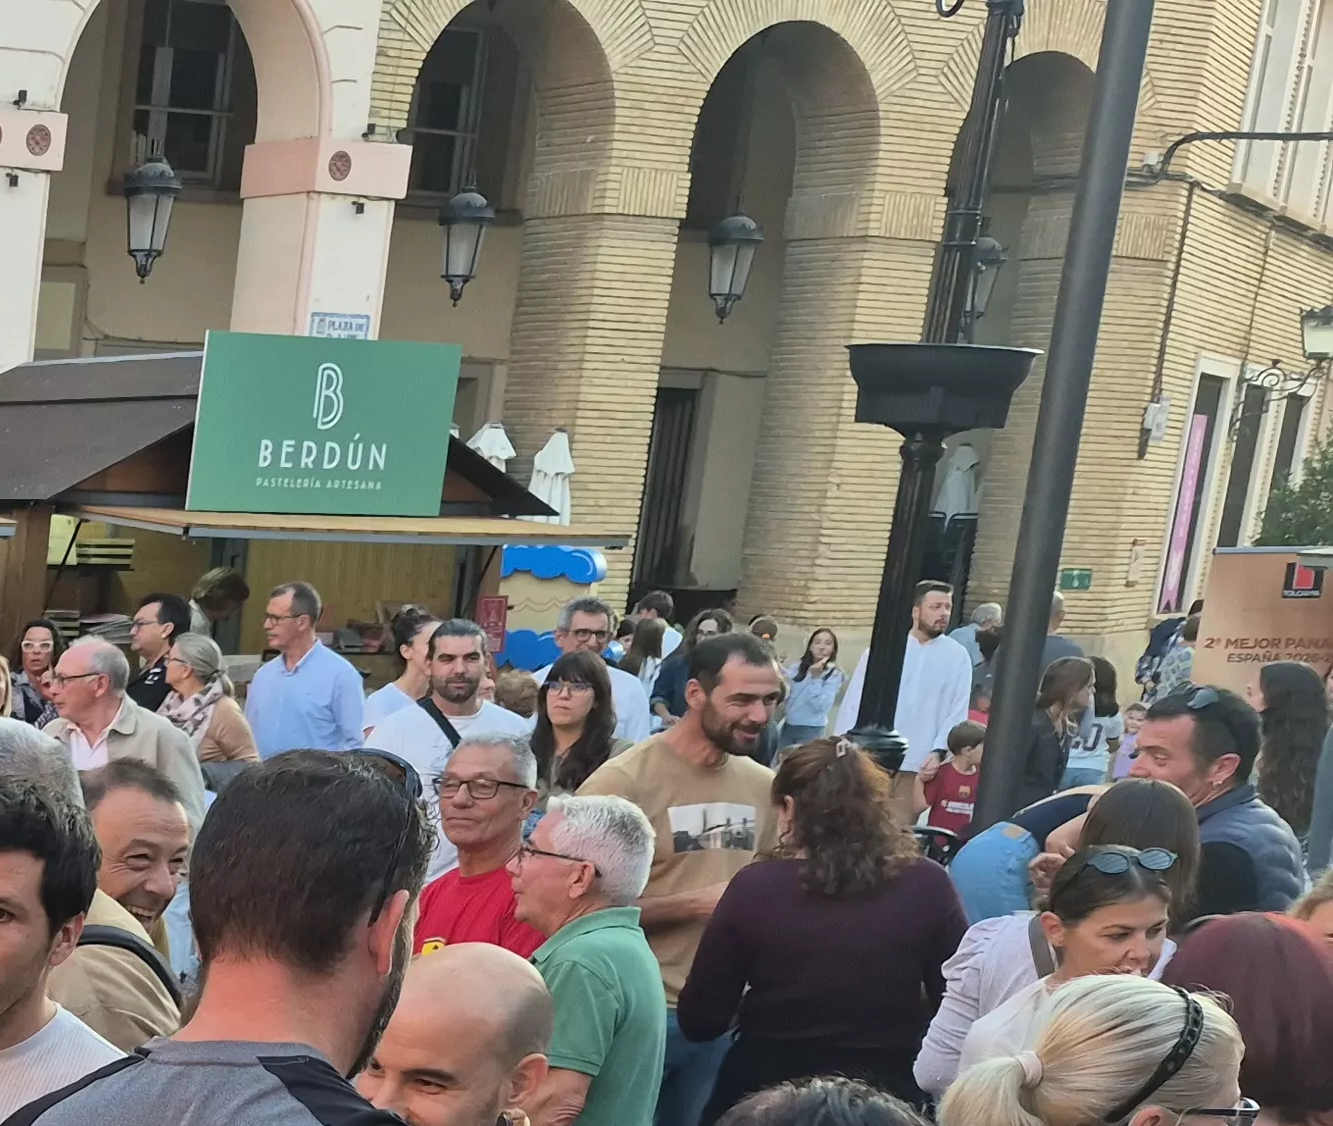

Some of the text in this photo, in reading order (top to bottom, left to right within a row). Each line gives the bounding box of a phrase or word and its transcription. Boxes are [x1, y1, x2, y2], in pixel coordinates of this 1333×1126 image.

[327, 320, 353, 332] PLAZA
[258, 432, 387, 471] BERDÚN
[255, 476, 383, 490] PASTELERÍA ARTESANA
[1224, 637, 1282, 650] MEJOR
[1226, 650, 1281, 664] ESPAÑA
